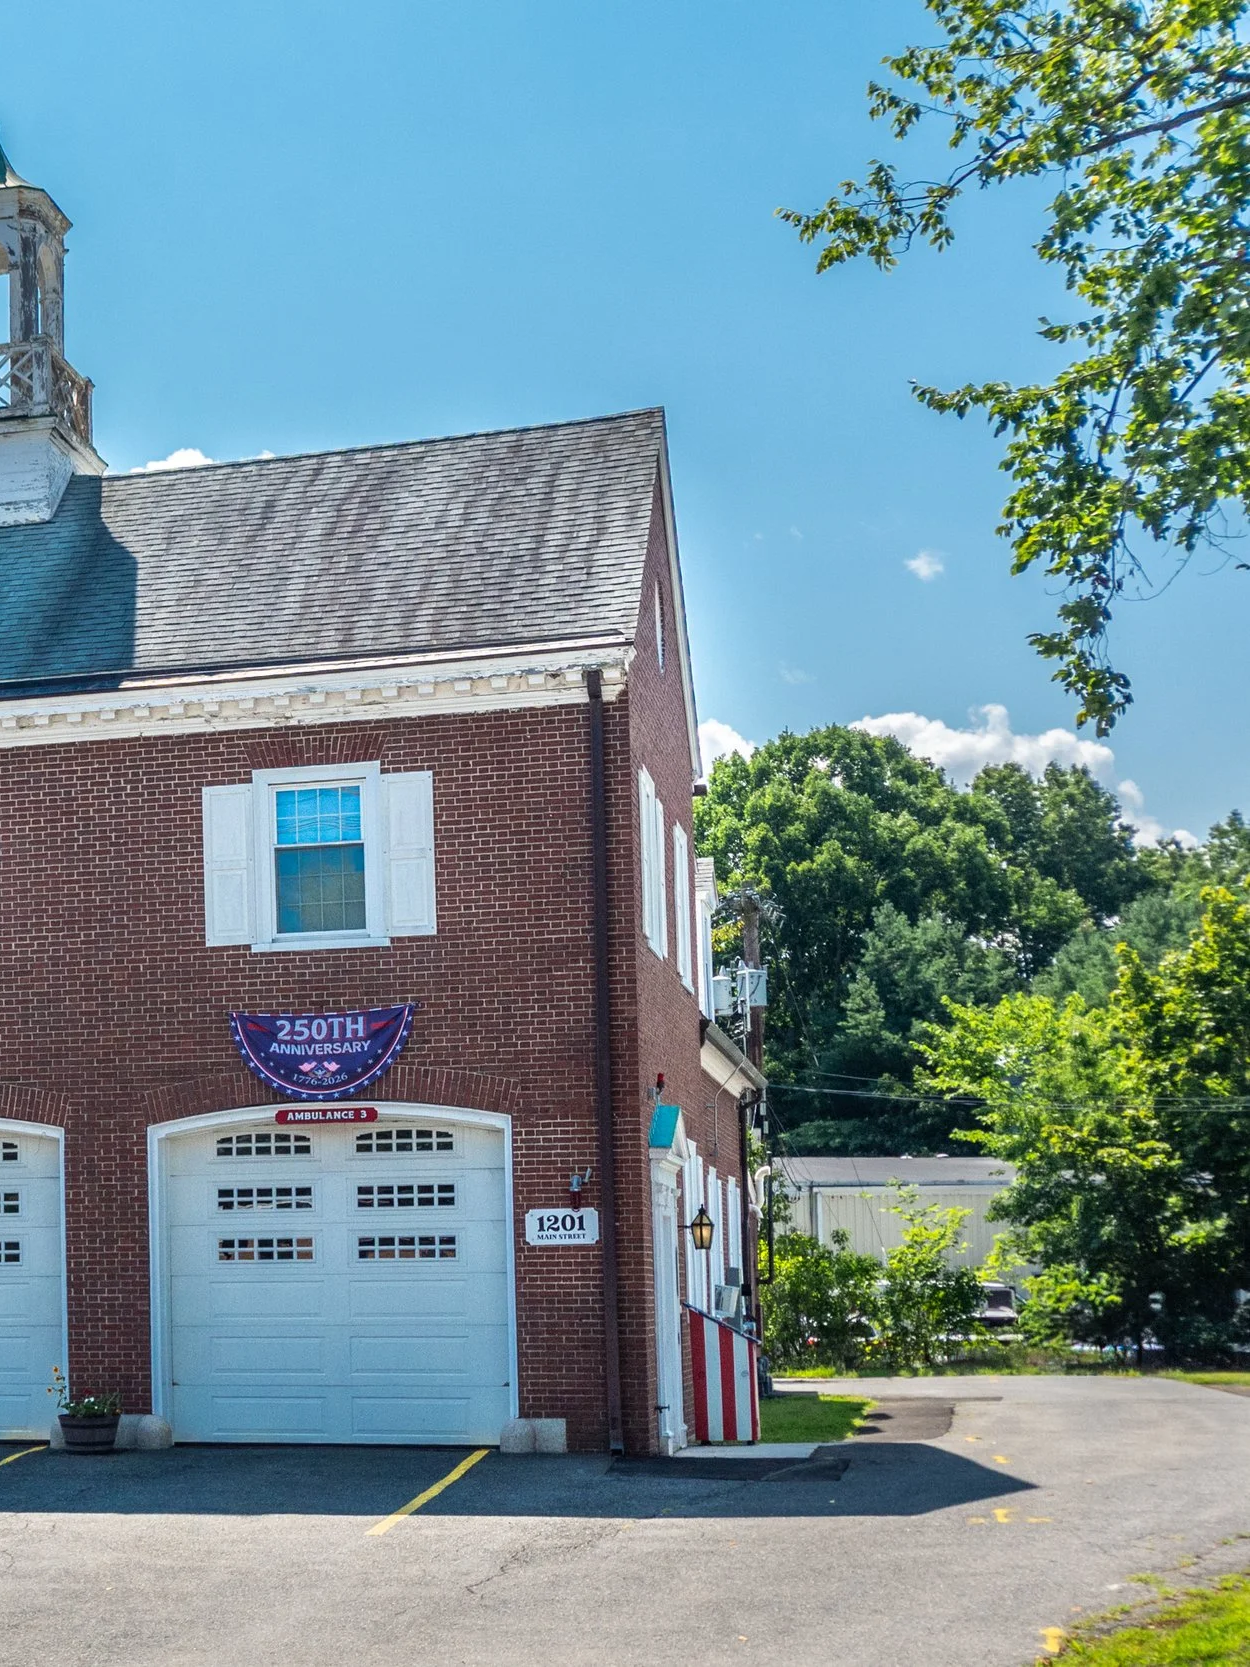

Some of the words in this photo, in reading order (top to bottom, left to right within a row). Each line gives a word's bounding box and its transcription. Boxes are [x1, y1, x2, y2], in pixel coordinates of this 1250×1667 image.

[275, 1016, 365, 1041] 250TH
[269, 1040, 371, 1055] ANNIVERSARY
[292, 1072, 348, 1086] 1776-2026
[287, 1110, 355, 1121] AMBULANCE
[360, 1110, 367, 1119] 3
[537, 1214, 586, 1232] 1201
